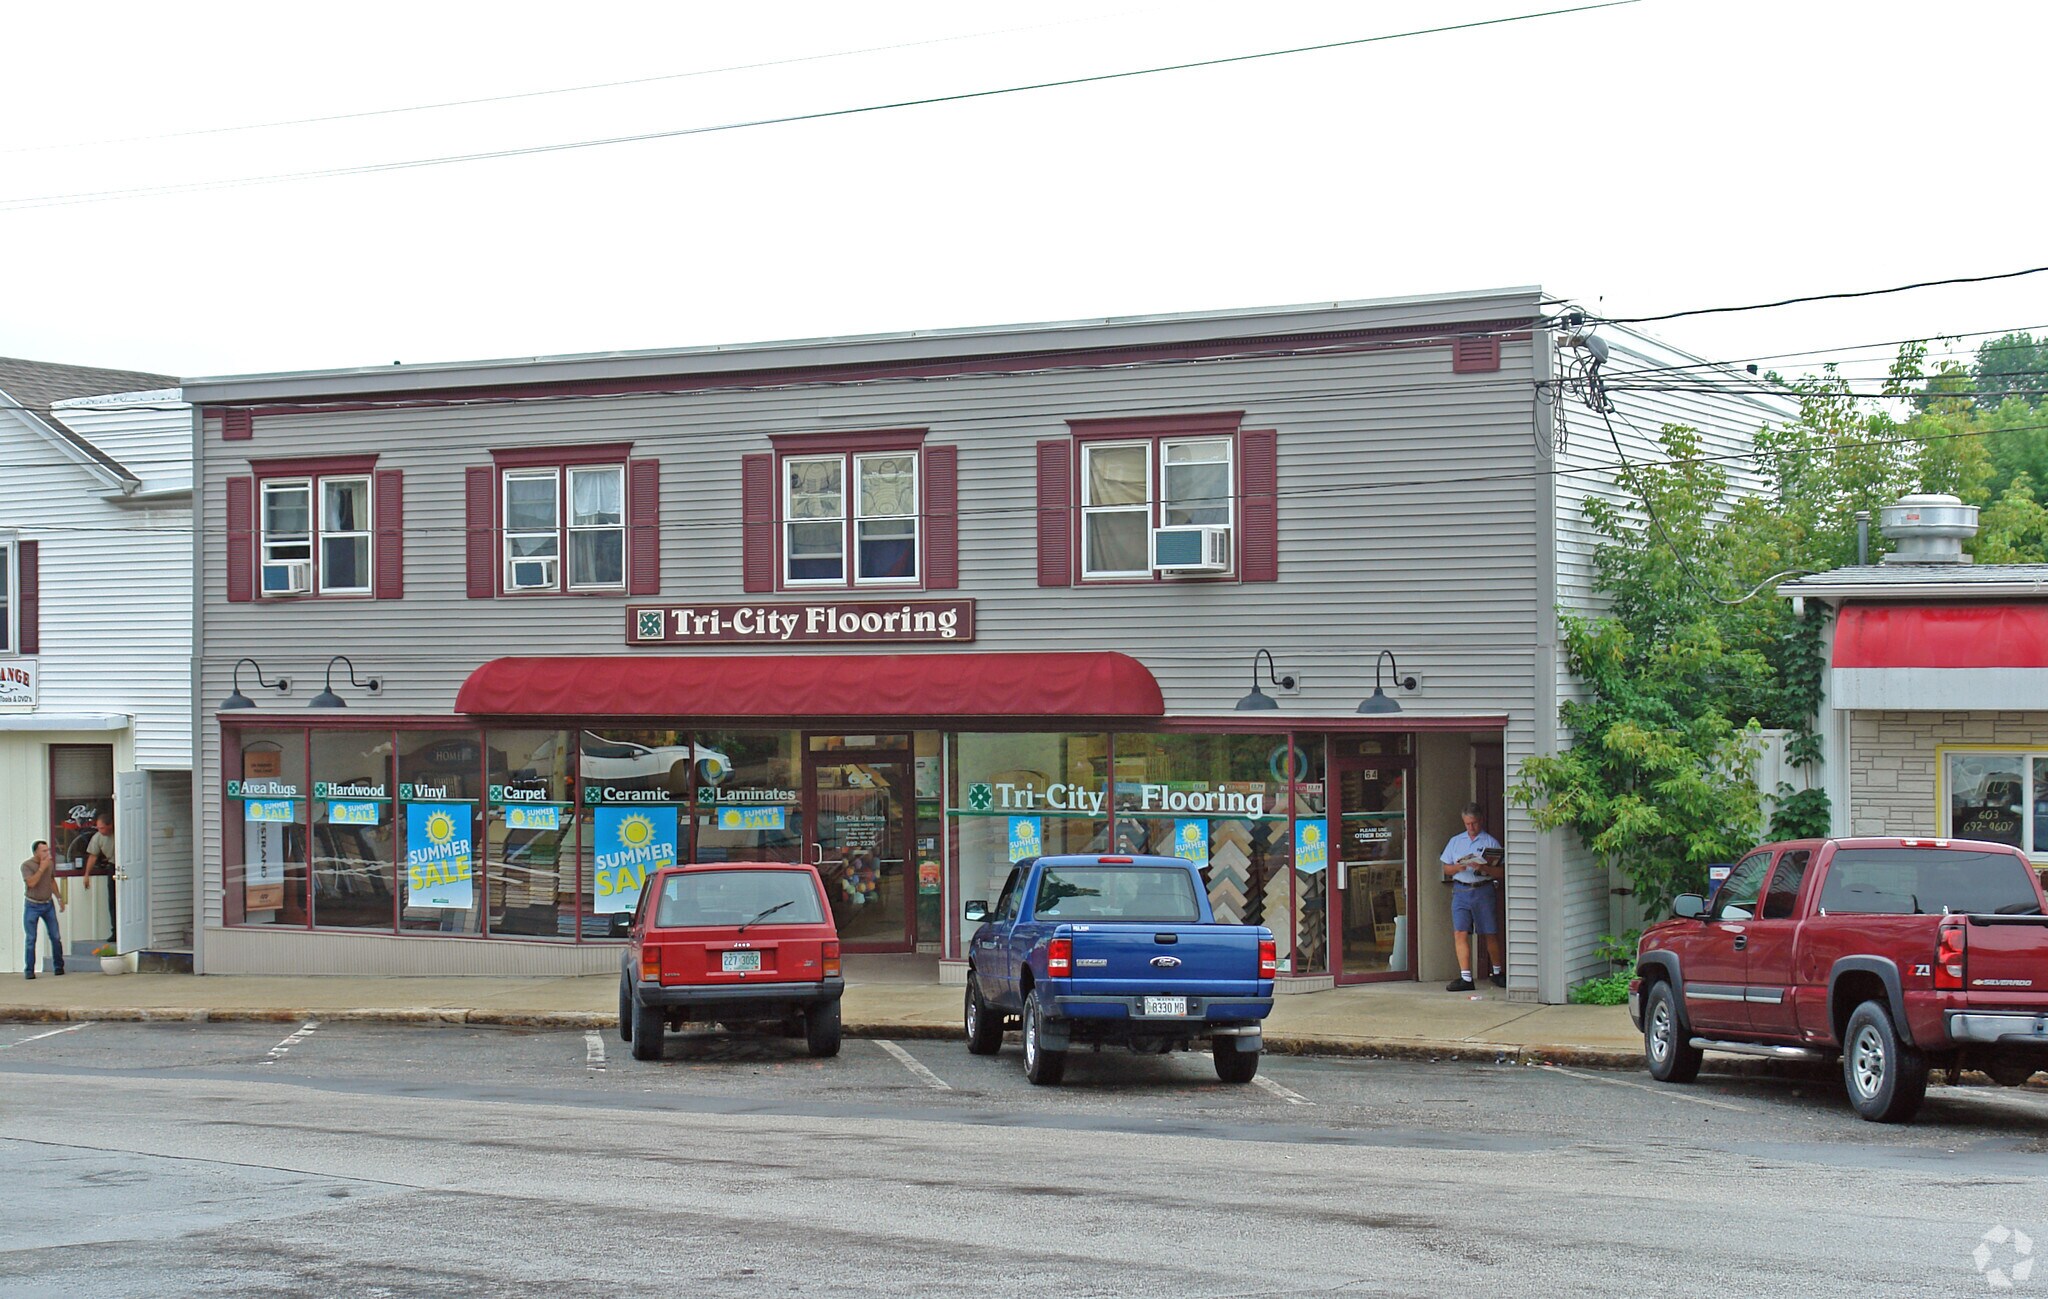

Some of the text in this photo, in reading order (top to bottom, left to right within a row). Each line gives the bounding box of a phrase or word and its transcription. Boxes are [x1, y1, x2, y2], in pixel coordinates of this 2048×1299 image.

[671, 606, 957, 640] Tri-City Flooring
[1365, 771, 1377, 779] 64
[241, 782, 297, 797] Area Rugs
[328, 783, 385, 797] Hardwood
[414, 784, 447, 799] Vinyl
[503, 786, 547, 802] Carpet
[603, 787, 670, 801] Ceramic
[716, 787, 796, 801] Laminates
[264, 801, 290, 810] SUMMER
[348, 803, 374, 812] SUMMER
[996, 783, 1264, 820] Tri-City Flooring
[265, 807, 290, 820] SALE
[349, 809, 375, 822] SALE
[526, 807, 554, 816] SUMMER
[743, 807, 778, 817] SUMMER
[1978, 809, 1999, 820] 603
[527, 813, 556, 827] SALE
[744, 813, 780, 829] SALE
[1010, 837, 1040, 848] SUMMER
[1176, 840, 1207, 852] SUMMER
[1296, 841, 1325, 855] SUMMER
[410, 839, 471, 865] SUMMER
[597, 842, 675, 870] SUMMER
[1009, 844, 1040, 859] SALE
[1296, 848, 1325, 867] SALE
[409, 855, 471, 891] SALE
[724, 955, 759, 966] 227 3092
[1907, 964, 1931, 976] Z71
